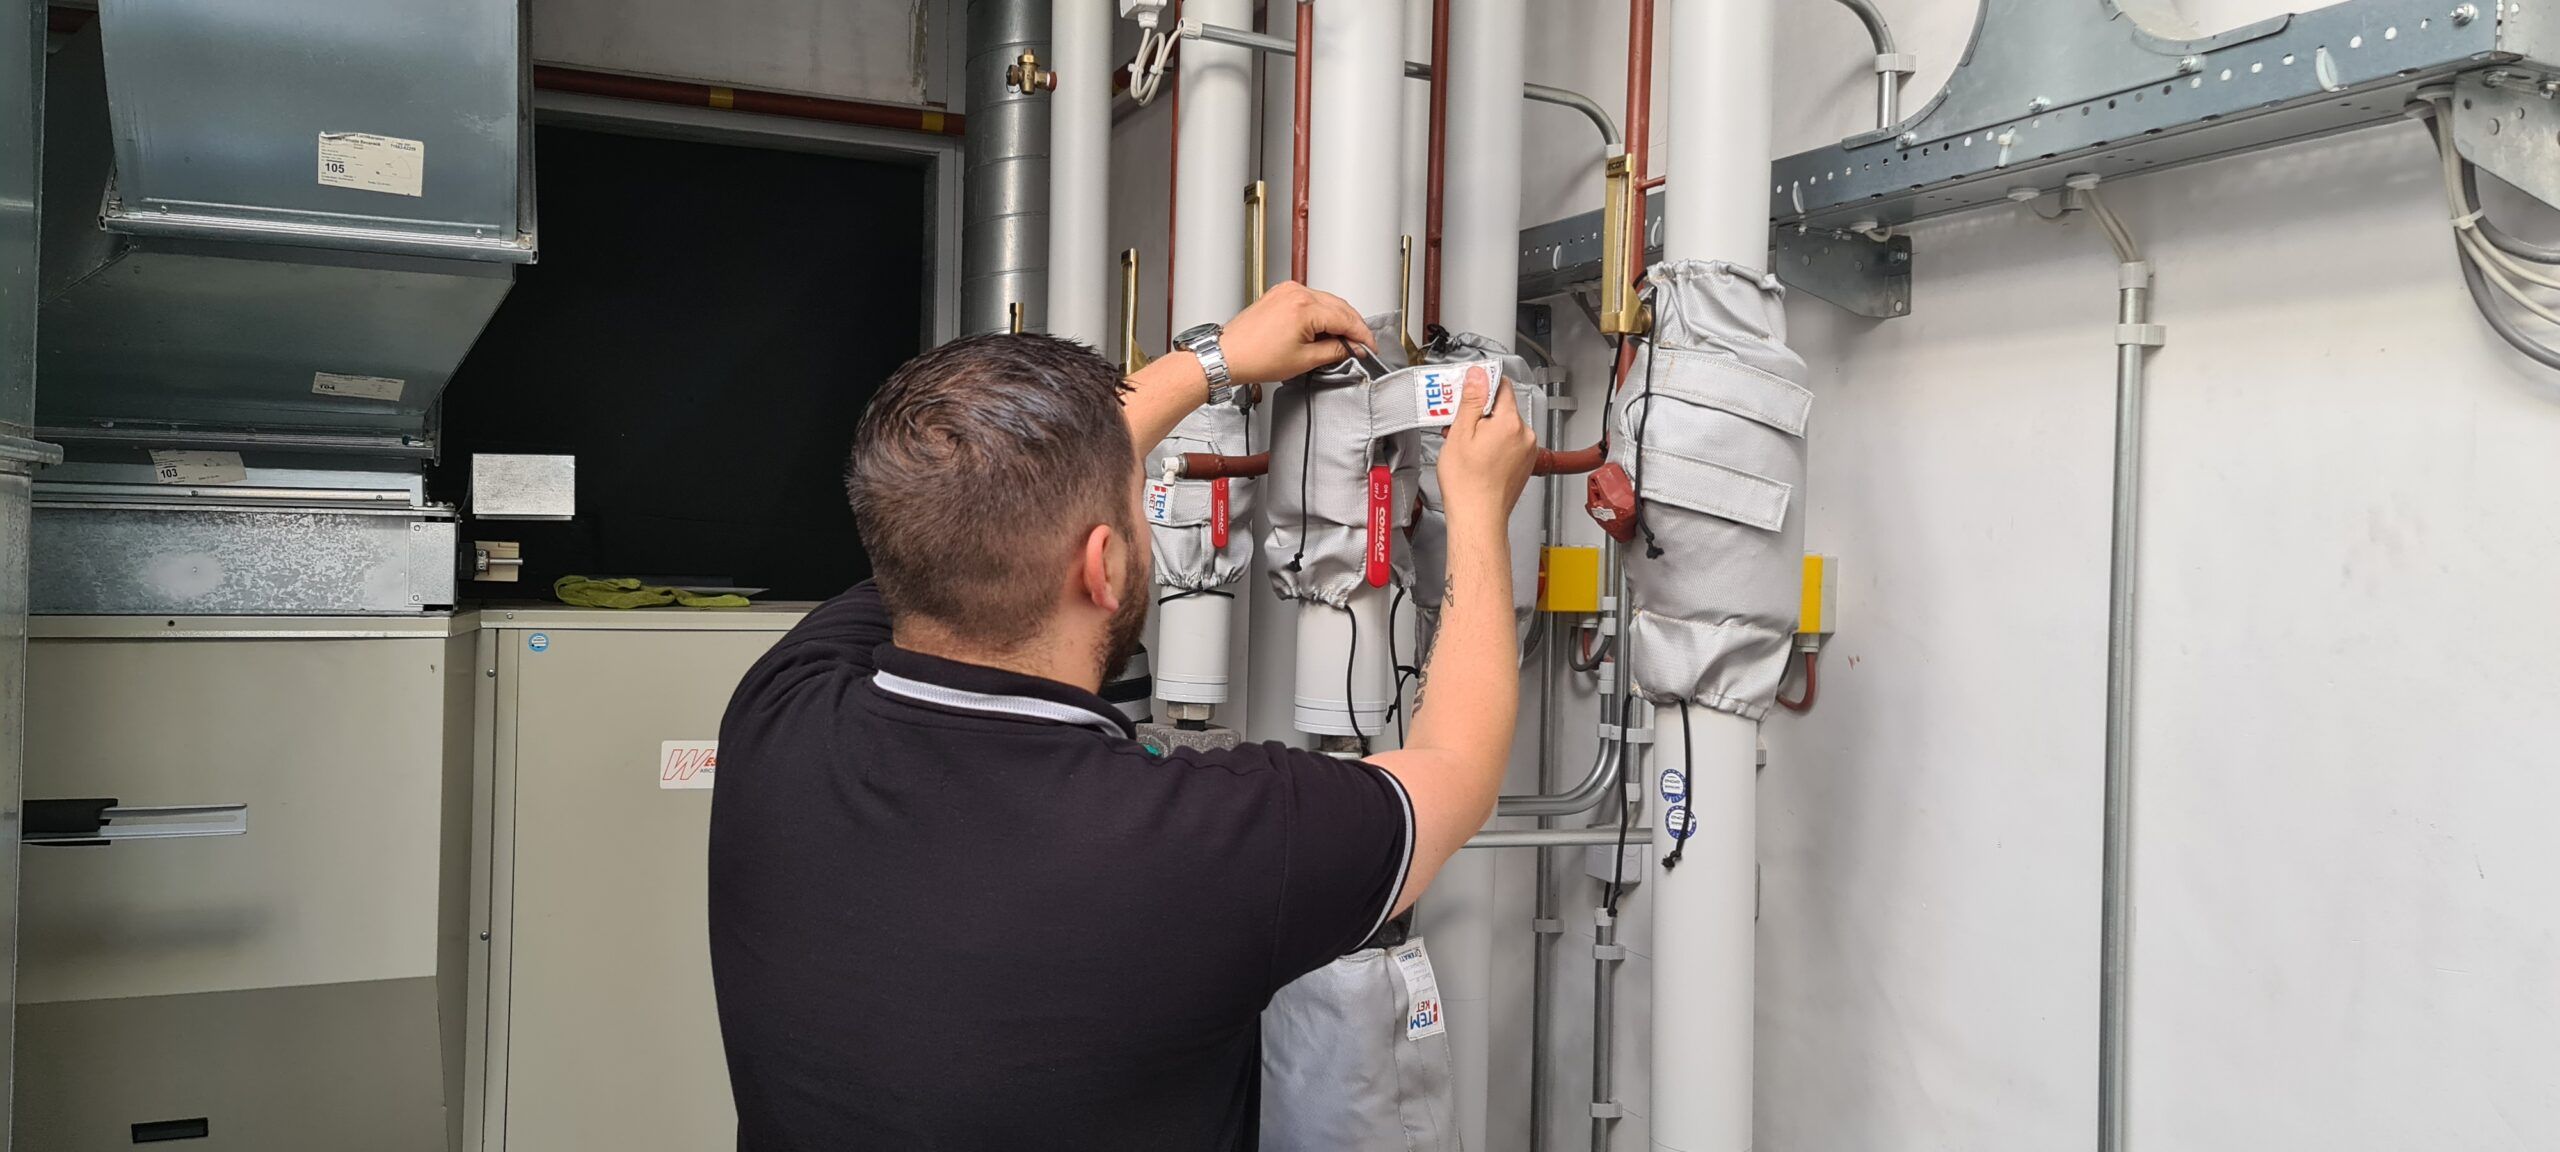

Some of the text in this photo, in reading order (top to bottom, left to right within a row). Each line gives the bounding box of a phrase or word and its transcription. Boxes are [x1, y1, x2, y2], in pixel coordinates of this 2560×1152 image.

[325, 162, 345, 174] 105
[1425, 373, 1442, 409] TEM
[1441, 383, 1453, 404] KET
[161, 468, 178, 479] 103
[1148, 493, 1156, 511] KET
[1154, 493, 1167, 520] TEM
[1377, 506, 1386, 564] COMAP
[1416, 1000, 1431, 1013] KET
[1410, 1011, 1433, 1030] TEM
